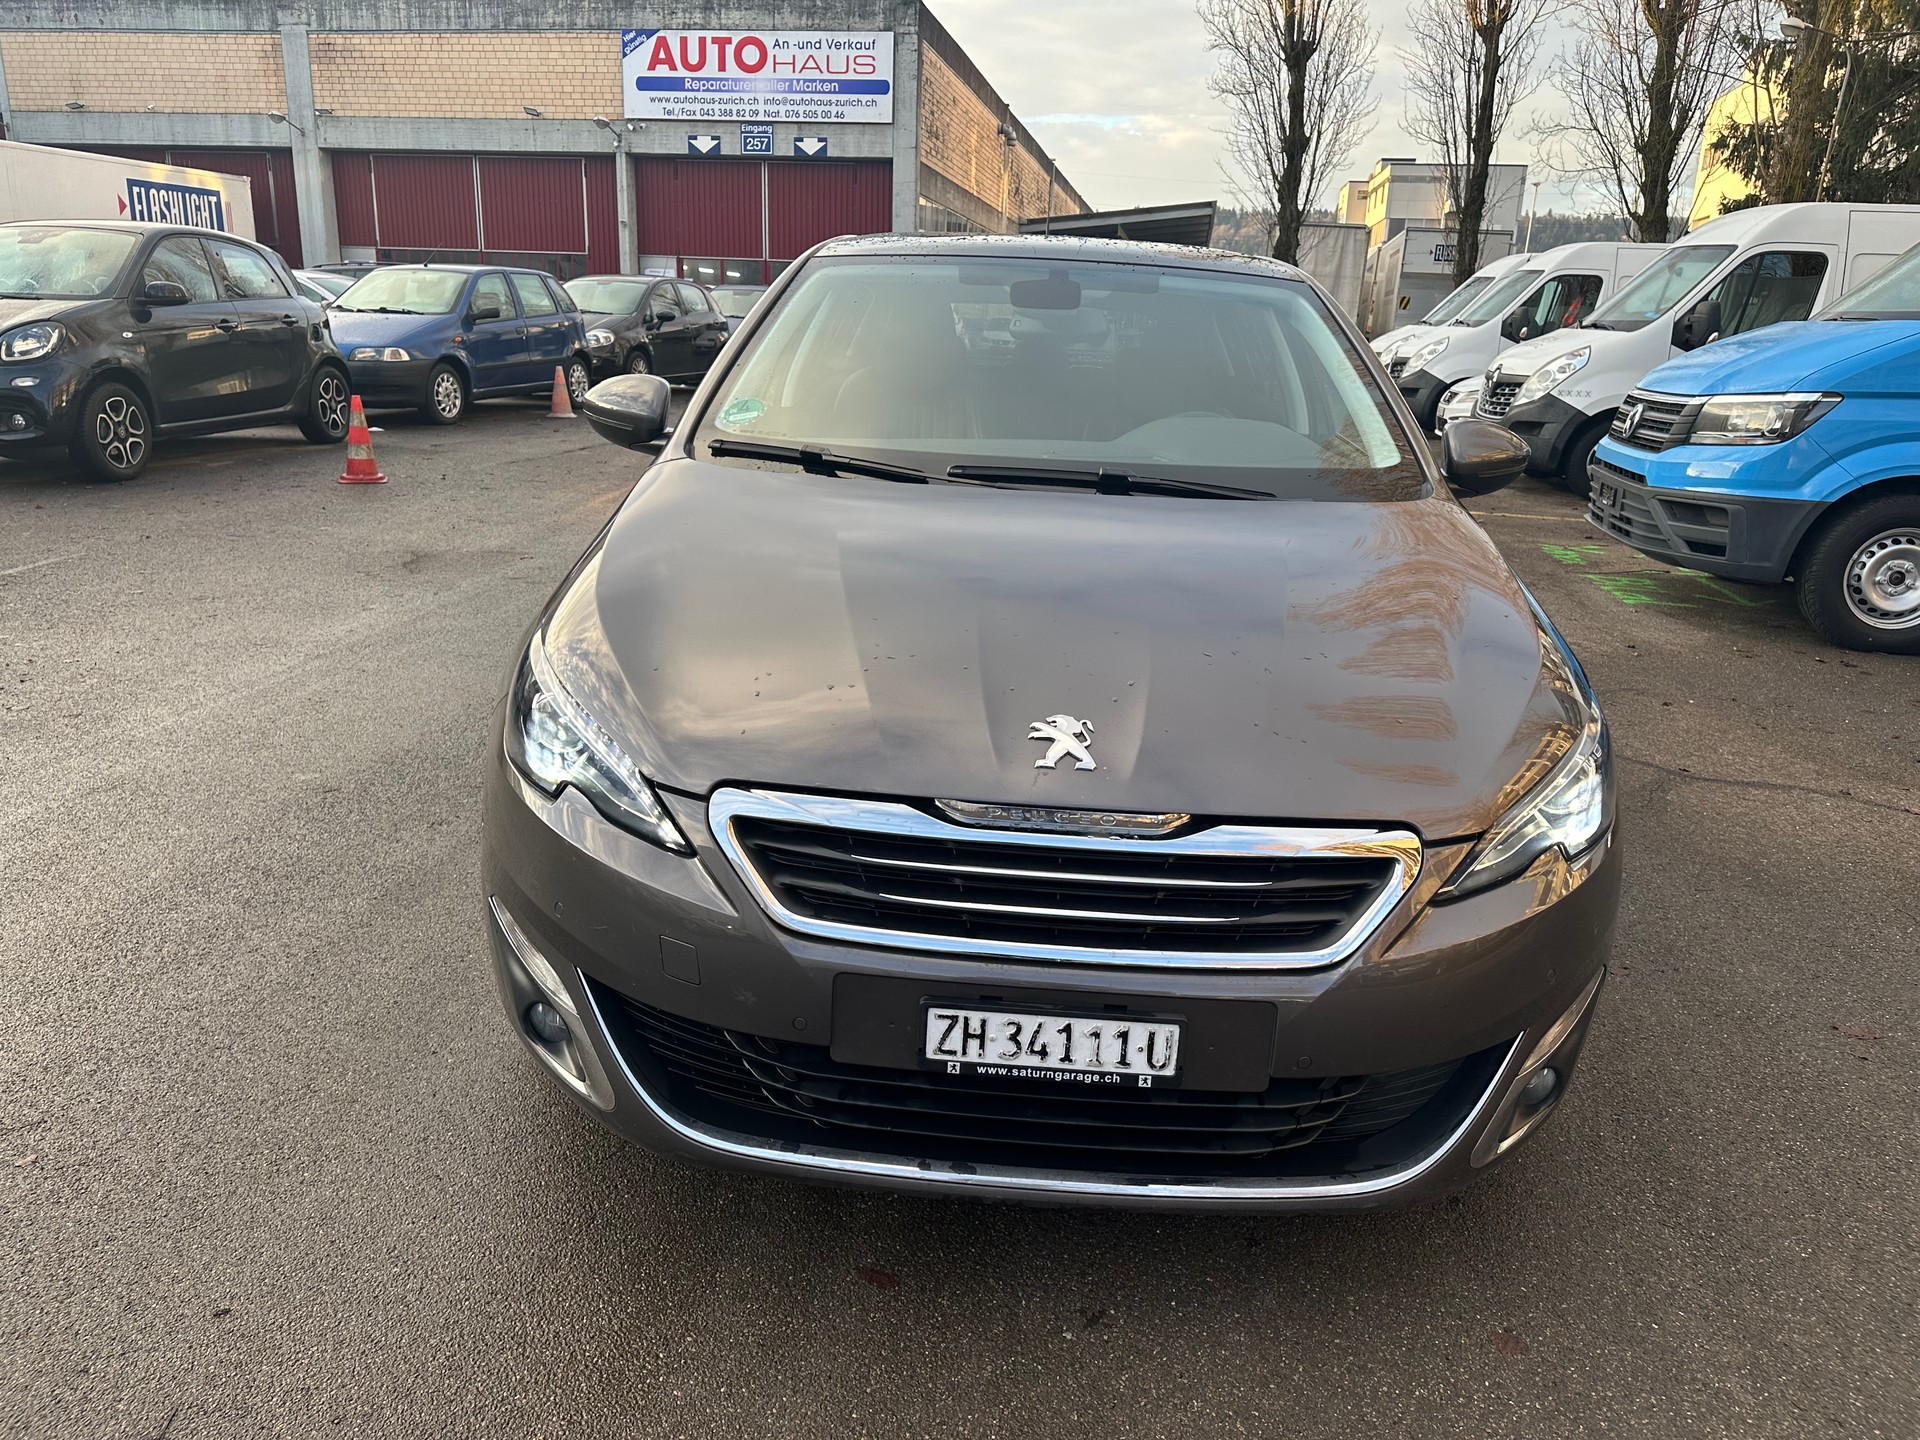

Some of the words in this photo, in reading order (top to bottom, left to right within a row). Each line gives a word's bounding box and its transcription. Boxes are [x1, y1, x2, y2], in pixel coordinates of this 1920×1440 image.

[622, 30, 637, 43] Hier
[624, 34, 648, 55] günstig
[772, 38, 790, 50] An
[825, 39, 876, 51] Verkauf
[647, 35, 768, 73] AUTO
[772, 54, 876, 75] HAUS
[792, 80, 839, 92] Marken
[649, 94, 759, 106] www.autohaus-zurich.ch
[763, 96, 877, 108] info@autohaus-zurich.ch
[699, 107, 716, 117] 043
[718, 108, 733, 118] 388
[735, 108, 747, 118] 82
[748, 108, 760, 118] 09
[763, 109, 782, 119] Nat.
[784, 109, 801, 119] 076
[802, 110, 819, 119] 505
[820, 110, 832, 119] 00
[833, 110, 846, 119] 46
[741, 123, 773, 134] Eingang
[746, 137, 769, 150] 257
[976, 1064, 1121, 1085] www.saturngarage.ch
